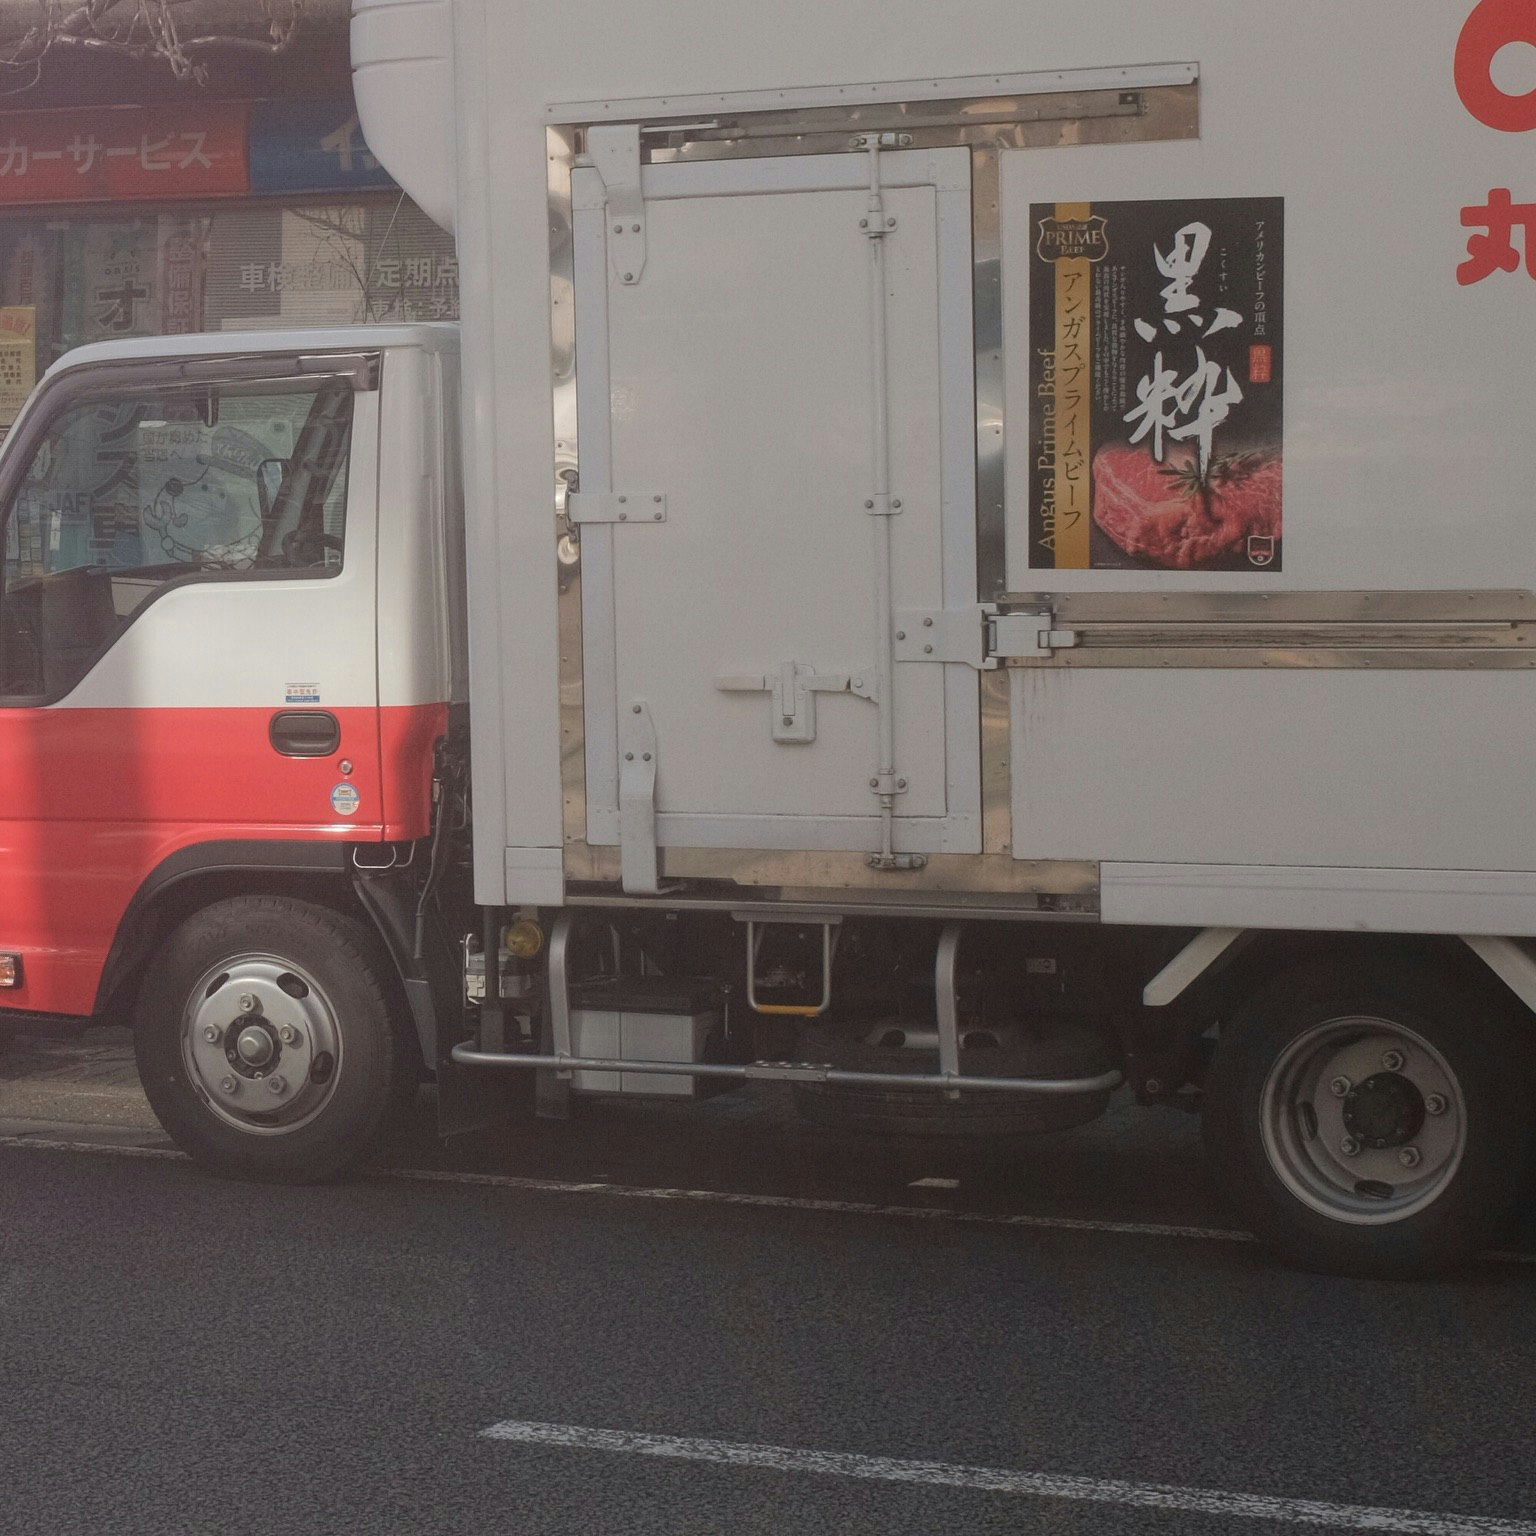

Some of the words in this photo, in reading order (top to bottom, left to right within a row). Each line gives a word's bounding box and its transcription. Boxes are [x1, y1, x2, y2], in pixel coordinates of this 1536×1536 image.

[1045, 230, 1102, 246] PRIME
[1218, 247, 1228, 293] こくすい
[1253, 221, 1267, 335] アメリカンビーフの頂点
[1037, 348, 1056, 396] Beef
[1062, 271, 1086, 530] アンガスプライムビーフ
[1037, 402, 1056, 472] Prime
[1037, 476, 1058, 552] Angus
